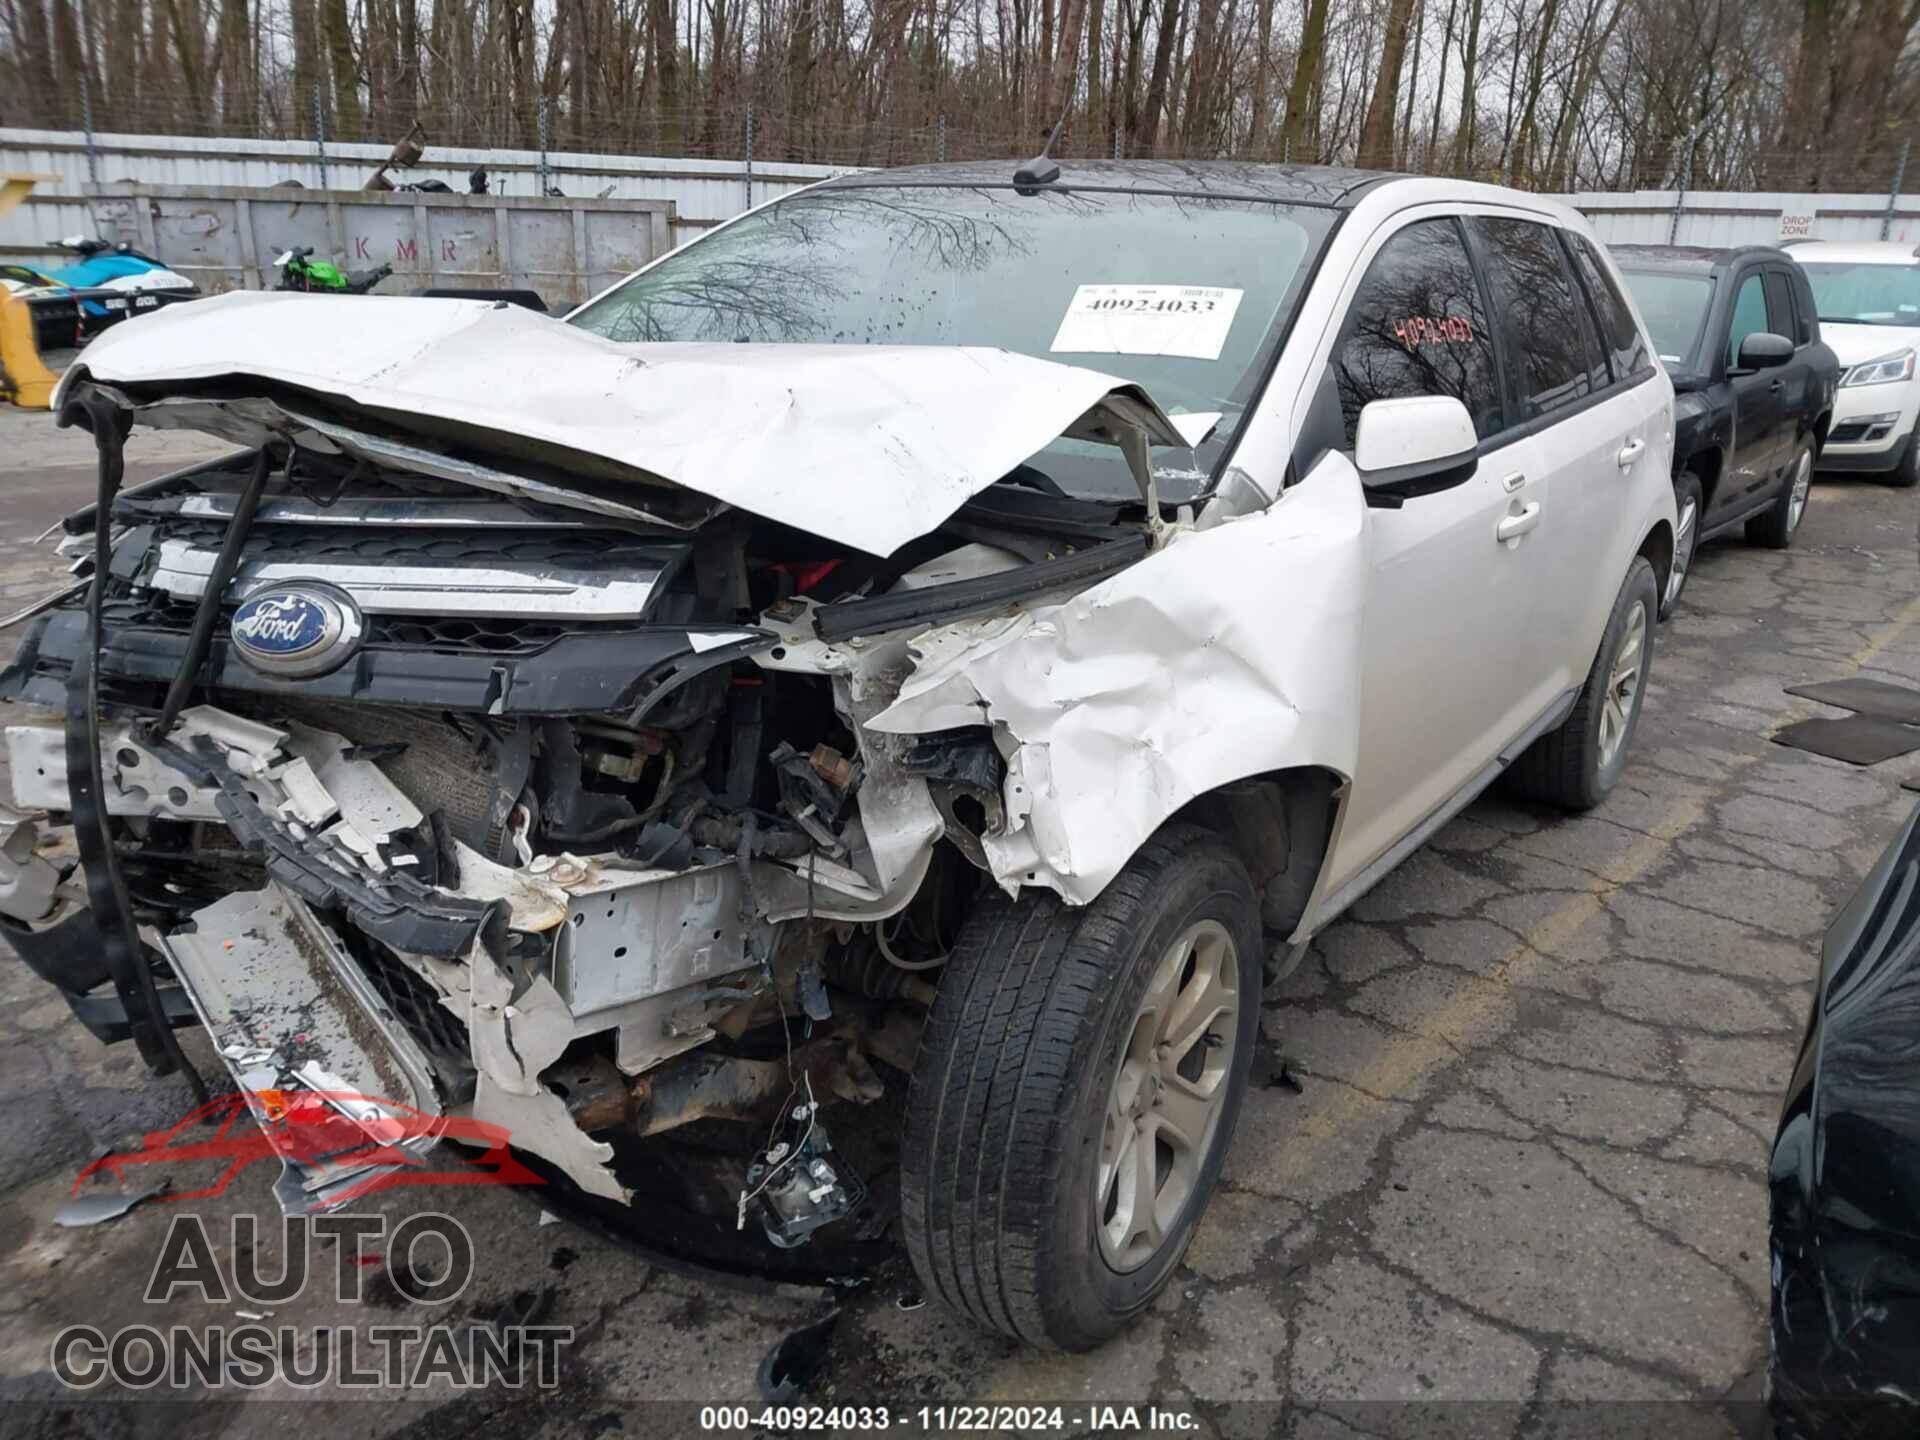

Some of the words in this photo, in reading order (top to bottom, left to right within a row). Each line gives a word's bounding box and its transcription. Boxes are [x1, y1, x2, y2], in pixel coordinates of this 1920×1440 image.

[1782, 215, 1813, 226] DROP
[1781, 225, 1808, 235] ZONE
[1086, 298, 1216, 315] 40924033
[236, 595, 307, 641] Ford
